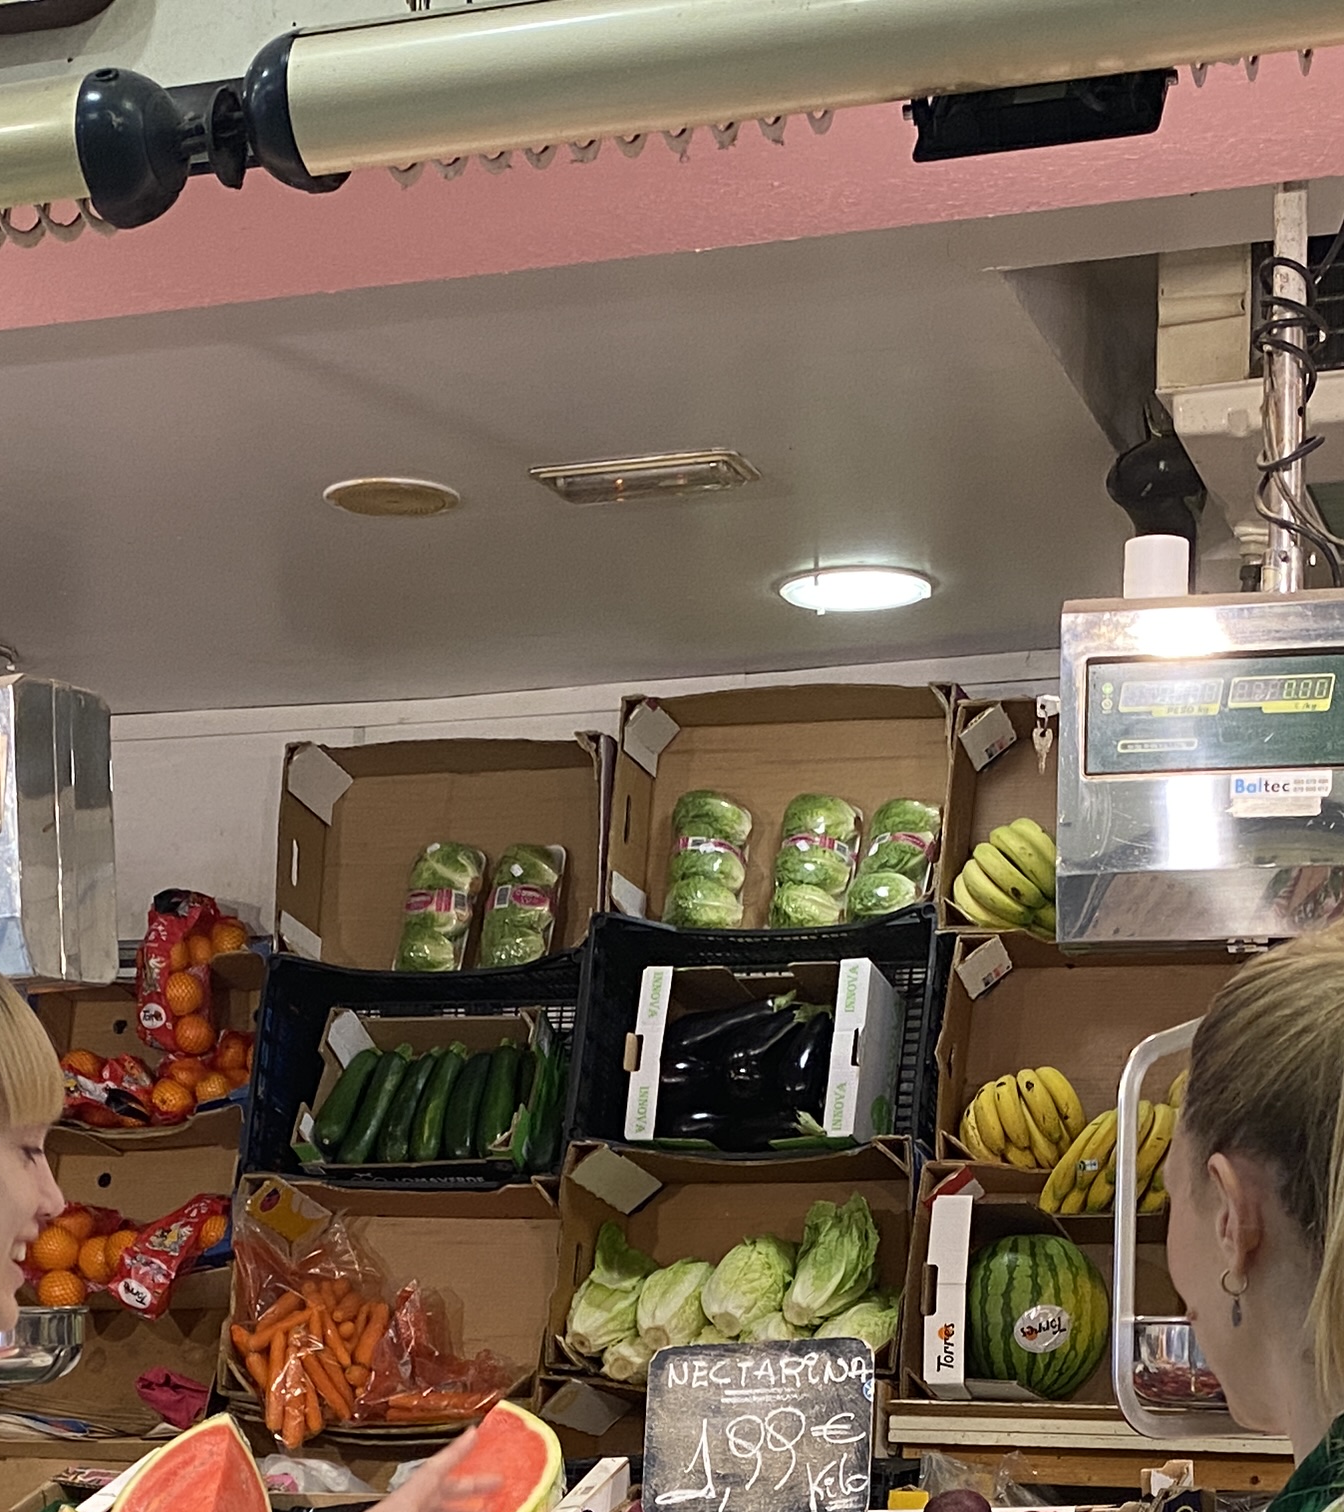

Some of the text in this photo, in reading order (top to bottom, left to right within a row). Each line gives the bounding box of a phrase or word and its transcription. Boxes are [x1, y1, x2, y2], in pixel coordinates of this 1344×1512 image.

[1234, 778, 1291, 794] Baltec
[648, 971, 663, 1018] INNOVA
[844, 965, 859, 1013] INNOVA
[635, 1086, 649, 1134] INNOVA
[831, 1081, 847, 1131] INNOVA
[937, 1323, 955, 1372] Torres
[1020, 1316, 1067, 1338] Torres
[810, 1412, 866, 1444] €
